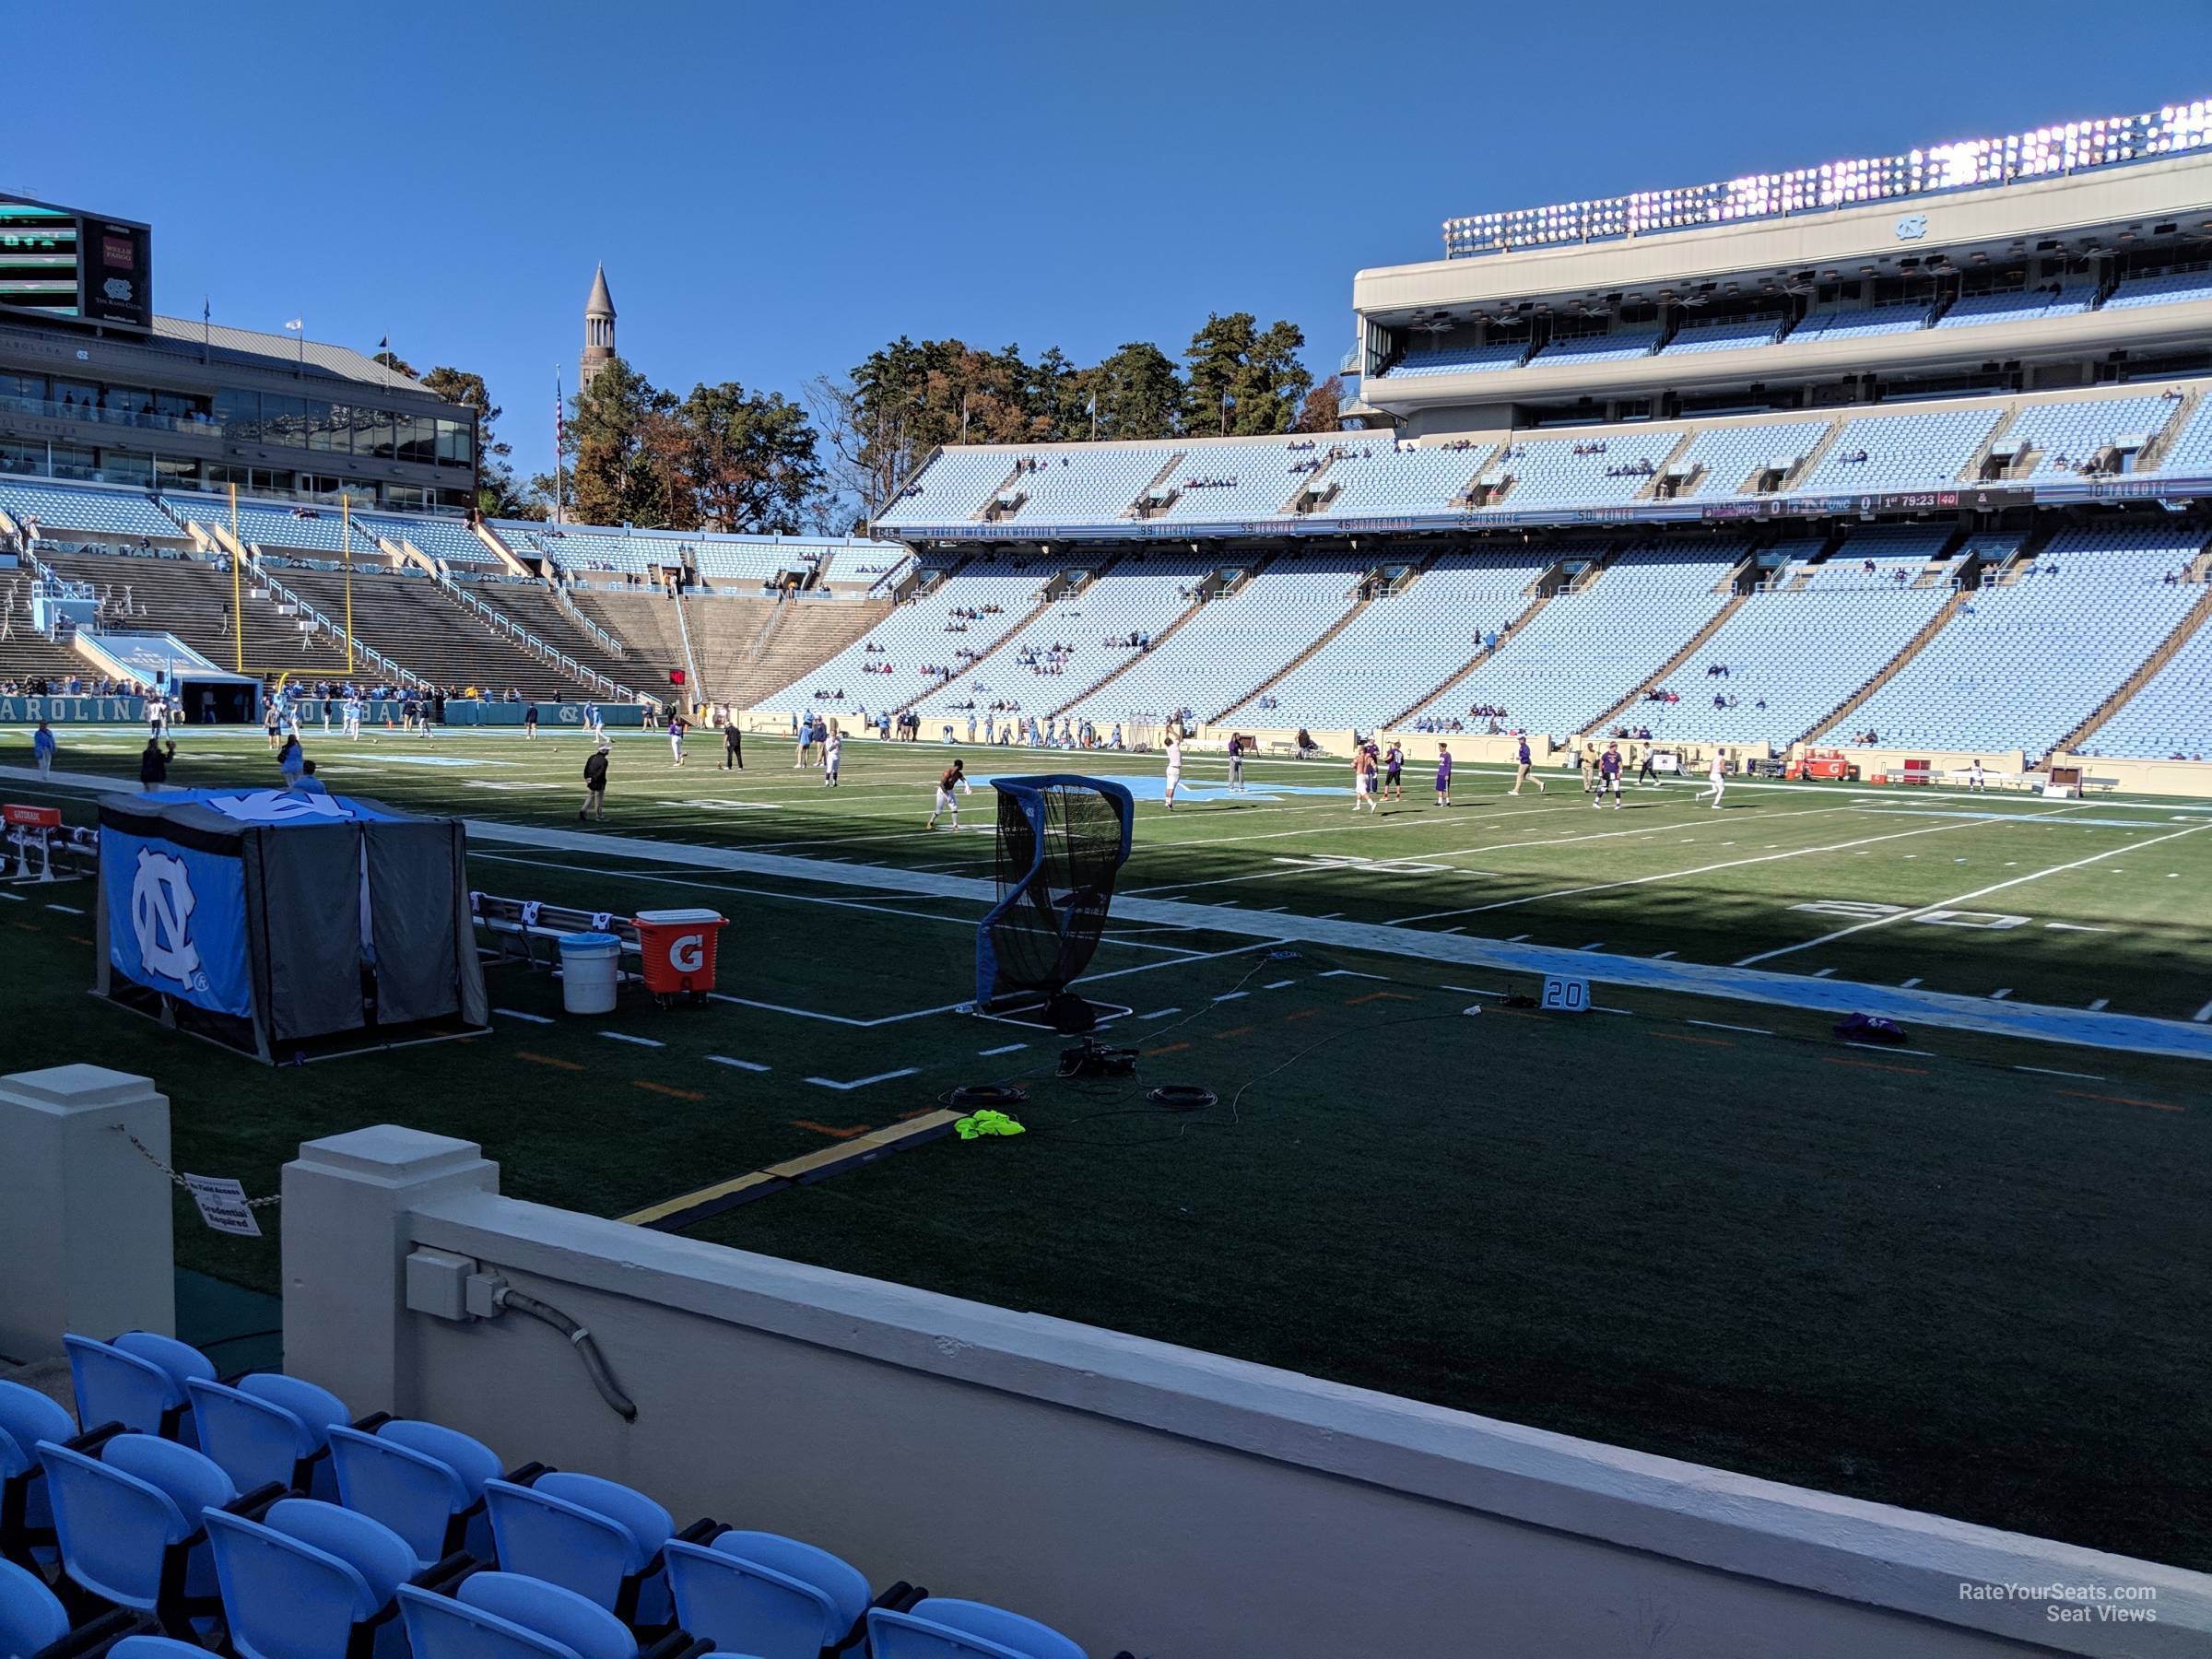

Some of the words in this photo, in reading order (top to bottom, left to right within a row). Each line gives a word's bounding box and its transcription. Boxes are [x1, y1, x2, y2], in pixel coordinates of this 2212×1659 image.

[2088, 485, 2102, 498] 10
[2109, 482, 2166, 497] TALBOTT
[1829, 500, 1851, 510] UNC
[1861, 497, 1871, 510] 0
[1902, 495, 1935, 507] 79:23
[1941, 496, 1955, 504] 40
[1738, 504, 1759, 513] WCU
[1771, 500, 1780, 513] 0
[1459, 515, 1472, 525] 22
[1476, 513, 1516, 525] JUSTICE
[1578, 510, 1592, 521] 50
[1596, 509, 1634, 521] WEINER
[1241, 523, 1253, 534] 59
[1255, 522, 1295, 533] BERSHAK
[1337, 520, 1350, 530] 46
[1353, 517, 1412, 530] SUTHERLAND
[877, 528, 894, 537] 1:45
[925, 527, 968, 537] WELCOME
[972, 528, 982, 537] TO
[985, 528, 1013, 537] KENAN
[1017, 527, 1057, 536] STADIUM
[1140, 525, 1152, 535] 99
[1155, 525, 1192, 535] BARCLAY
[1829, 763, 1840, 773] G
[1786, 900, 2033, 929] 20
[669, 935, 703, 972] G
[1547, 981, 1583, 1007] 20
[215, 1187, 241, 1195] Access
[201, 1203, 248, 1218] Credential
[208, 1214, 249, 1228] Required
